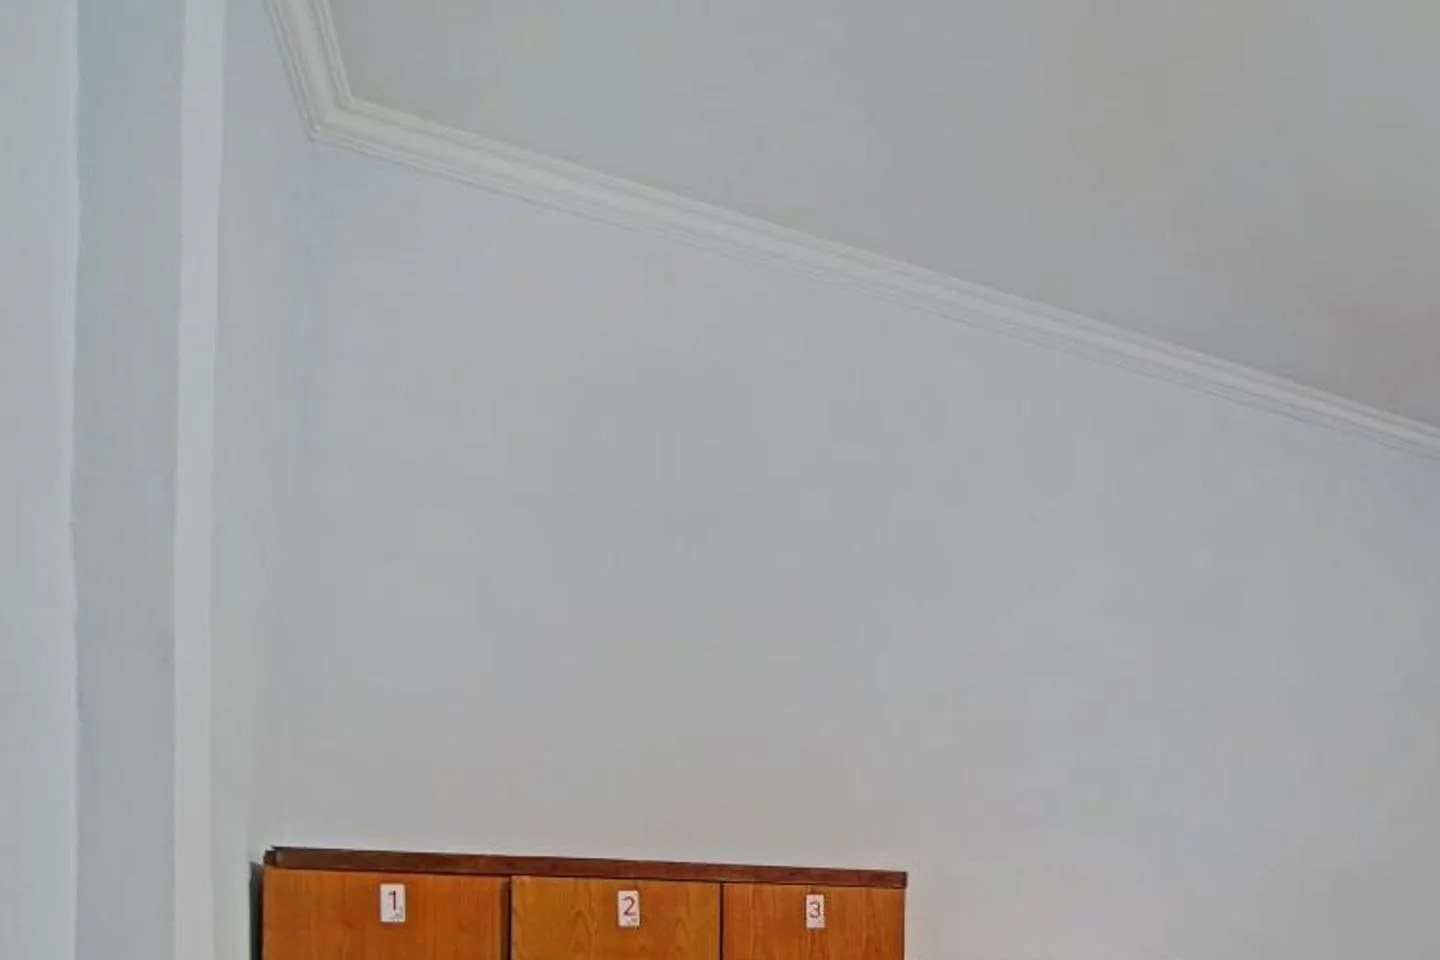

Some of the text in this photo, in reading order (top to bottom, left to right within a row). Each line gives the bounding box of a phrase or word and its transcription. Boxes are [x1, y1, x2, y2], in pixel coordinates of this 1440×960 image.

[388, 890, 397, 911] 1
[622, 896, 637, 916] 2
[809, 901, 820, 919] 3
